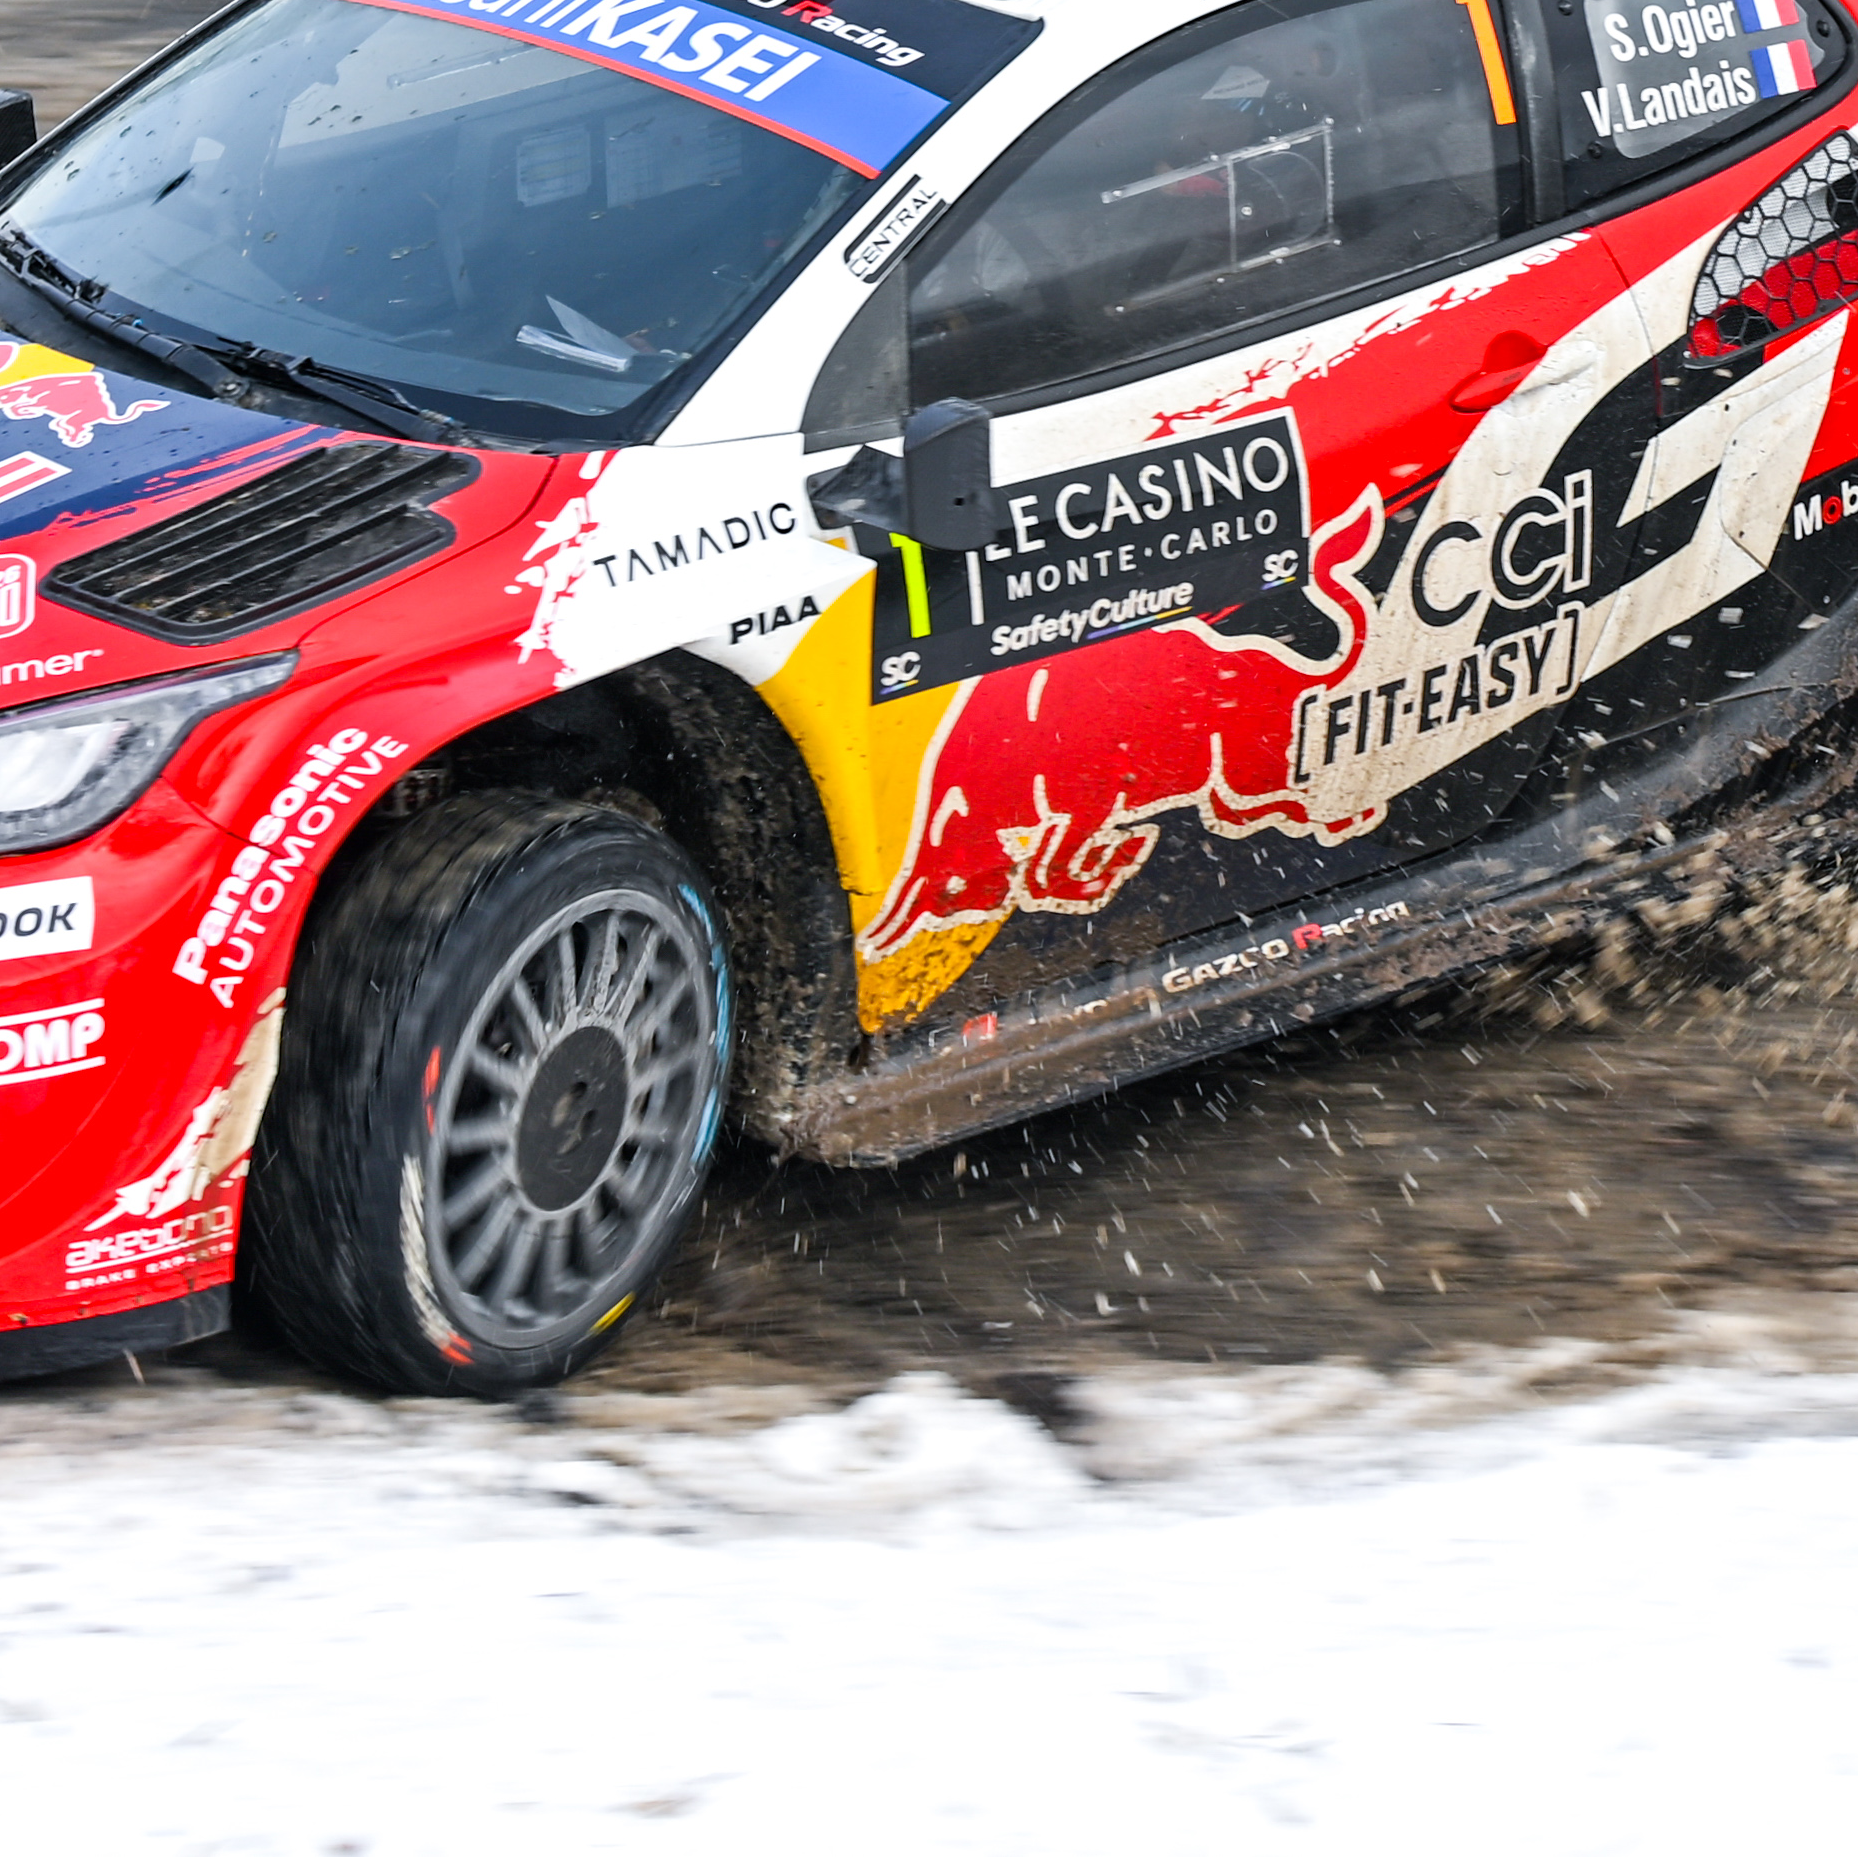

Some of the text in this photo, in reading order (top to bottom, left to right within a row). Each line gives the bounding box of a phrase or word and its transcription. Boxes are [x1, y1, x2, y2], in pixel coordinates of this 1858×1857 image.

[780, 0, 926, 67] Racing
[1580, 59, 1757, 139] V.Landais
[848, 189, 939, 278] CENTRAL
[1055, 436, 1290, 541] CASINO
[593, 502, 797, 588] TAMADIC
[889, 532, 931, 639] 1
[1261, 549, 1299, 583] SC
[728, 595, 823, 645] PIAA
[880, 651, 922, 687] SC
[172, 728, 369, 985] Panasonic
[209, 736, 409, 1009] AUTOMOTIVE
[65, 1268, 137, 1291] BRAKE
